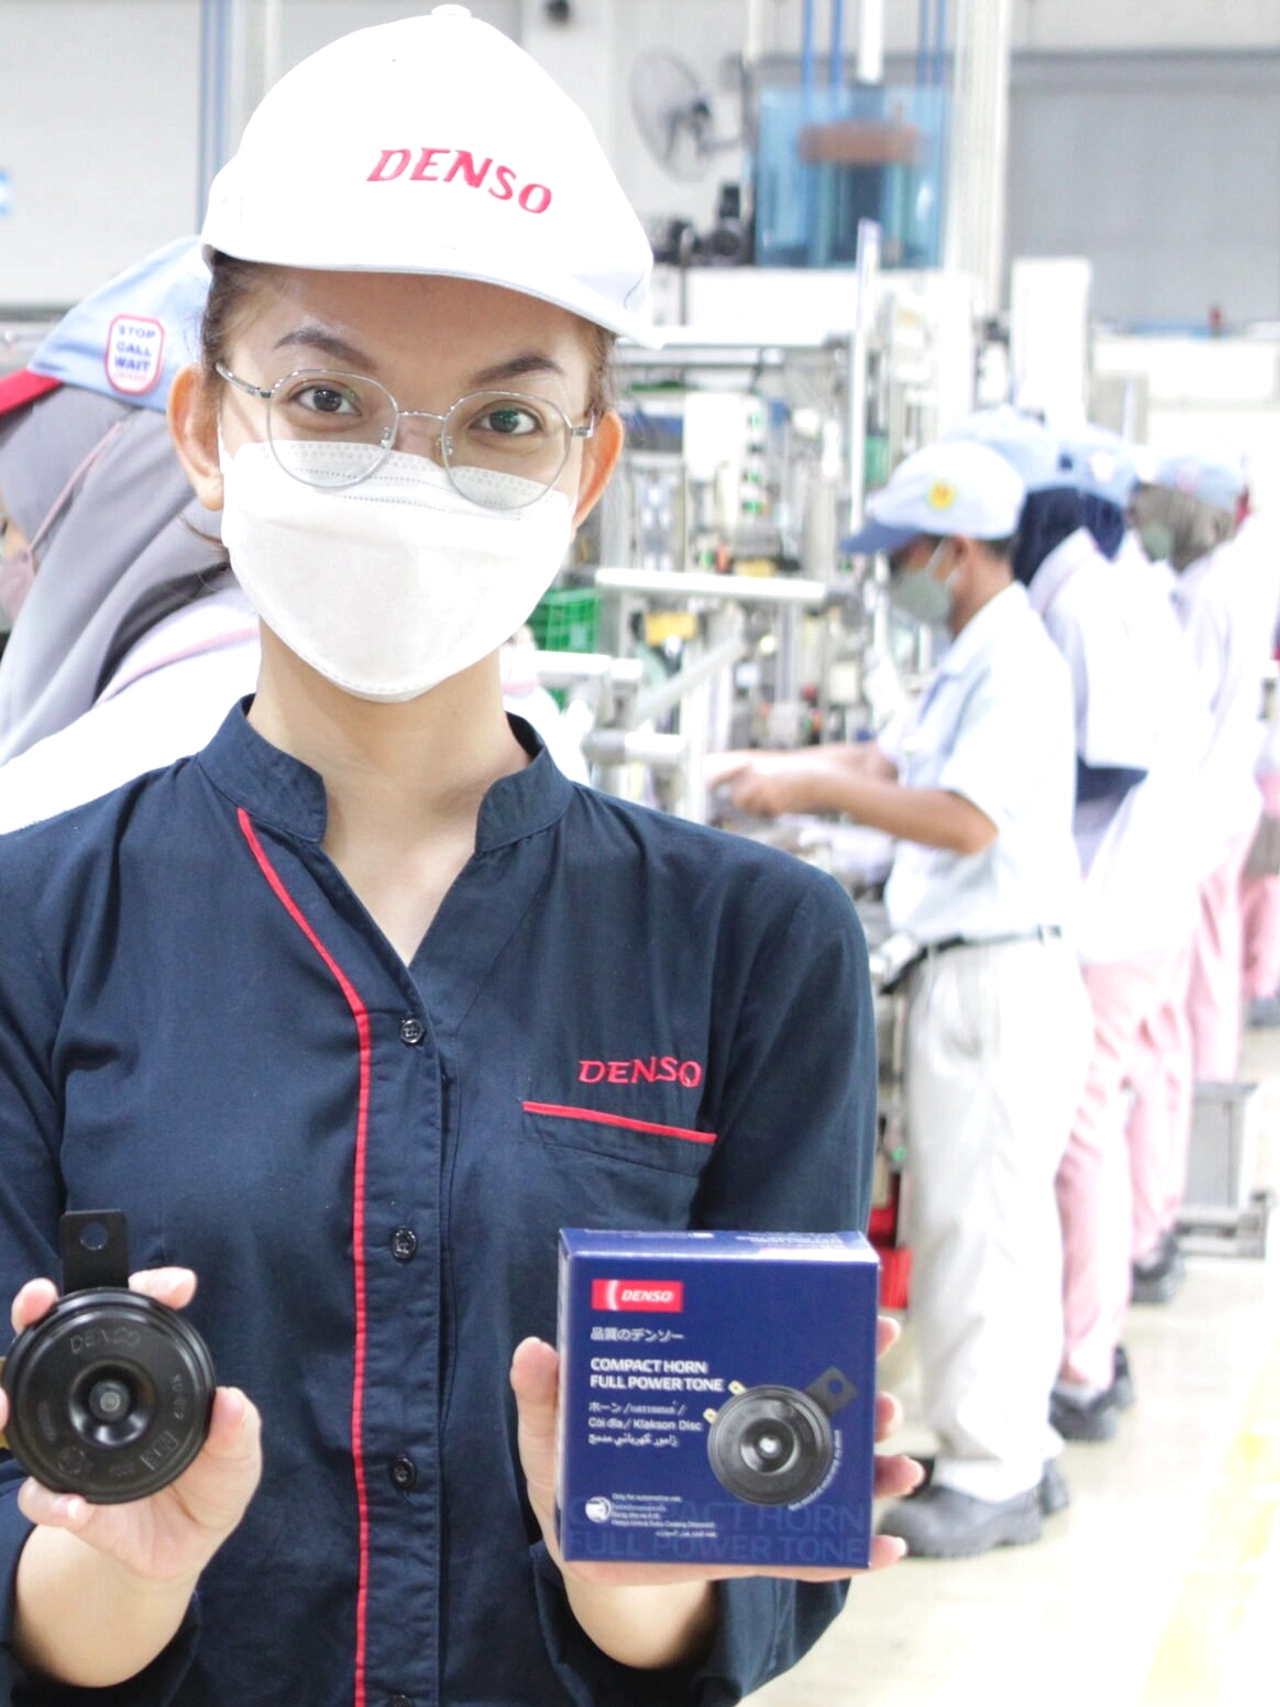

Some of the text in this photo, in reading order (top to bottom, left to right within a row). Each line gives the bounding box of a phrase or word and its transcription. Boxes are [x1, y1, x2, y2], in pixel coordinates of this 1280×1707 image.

[366, 147, 552, 214] DENSO
[118, 325, 156, 339] STOP
[116, 341, 151, 357] CALL
[114, 355, 151, 372] WAIT
[578, 1056, 702, 1088] DENSO
[621, 1290, 674, 1303] DENSO
[590, 1358, 708, 1374] COMPACT HORN
[590, 1375, 724, 1392] FULL POWER TONE
[633, 1418, 676, 1430] Klakson
[679, 1419, 704, 1431] Disc
